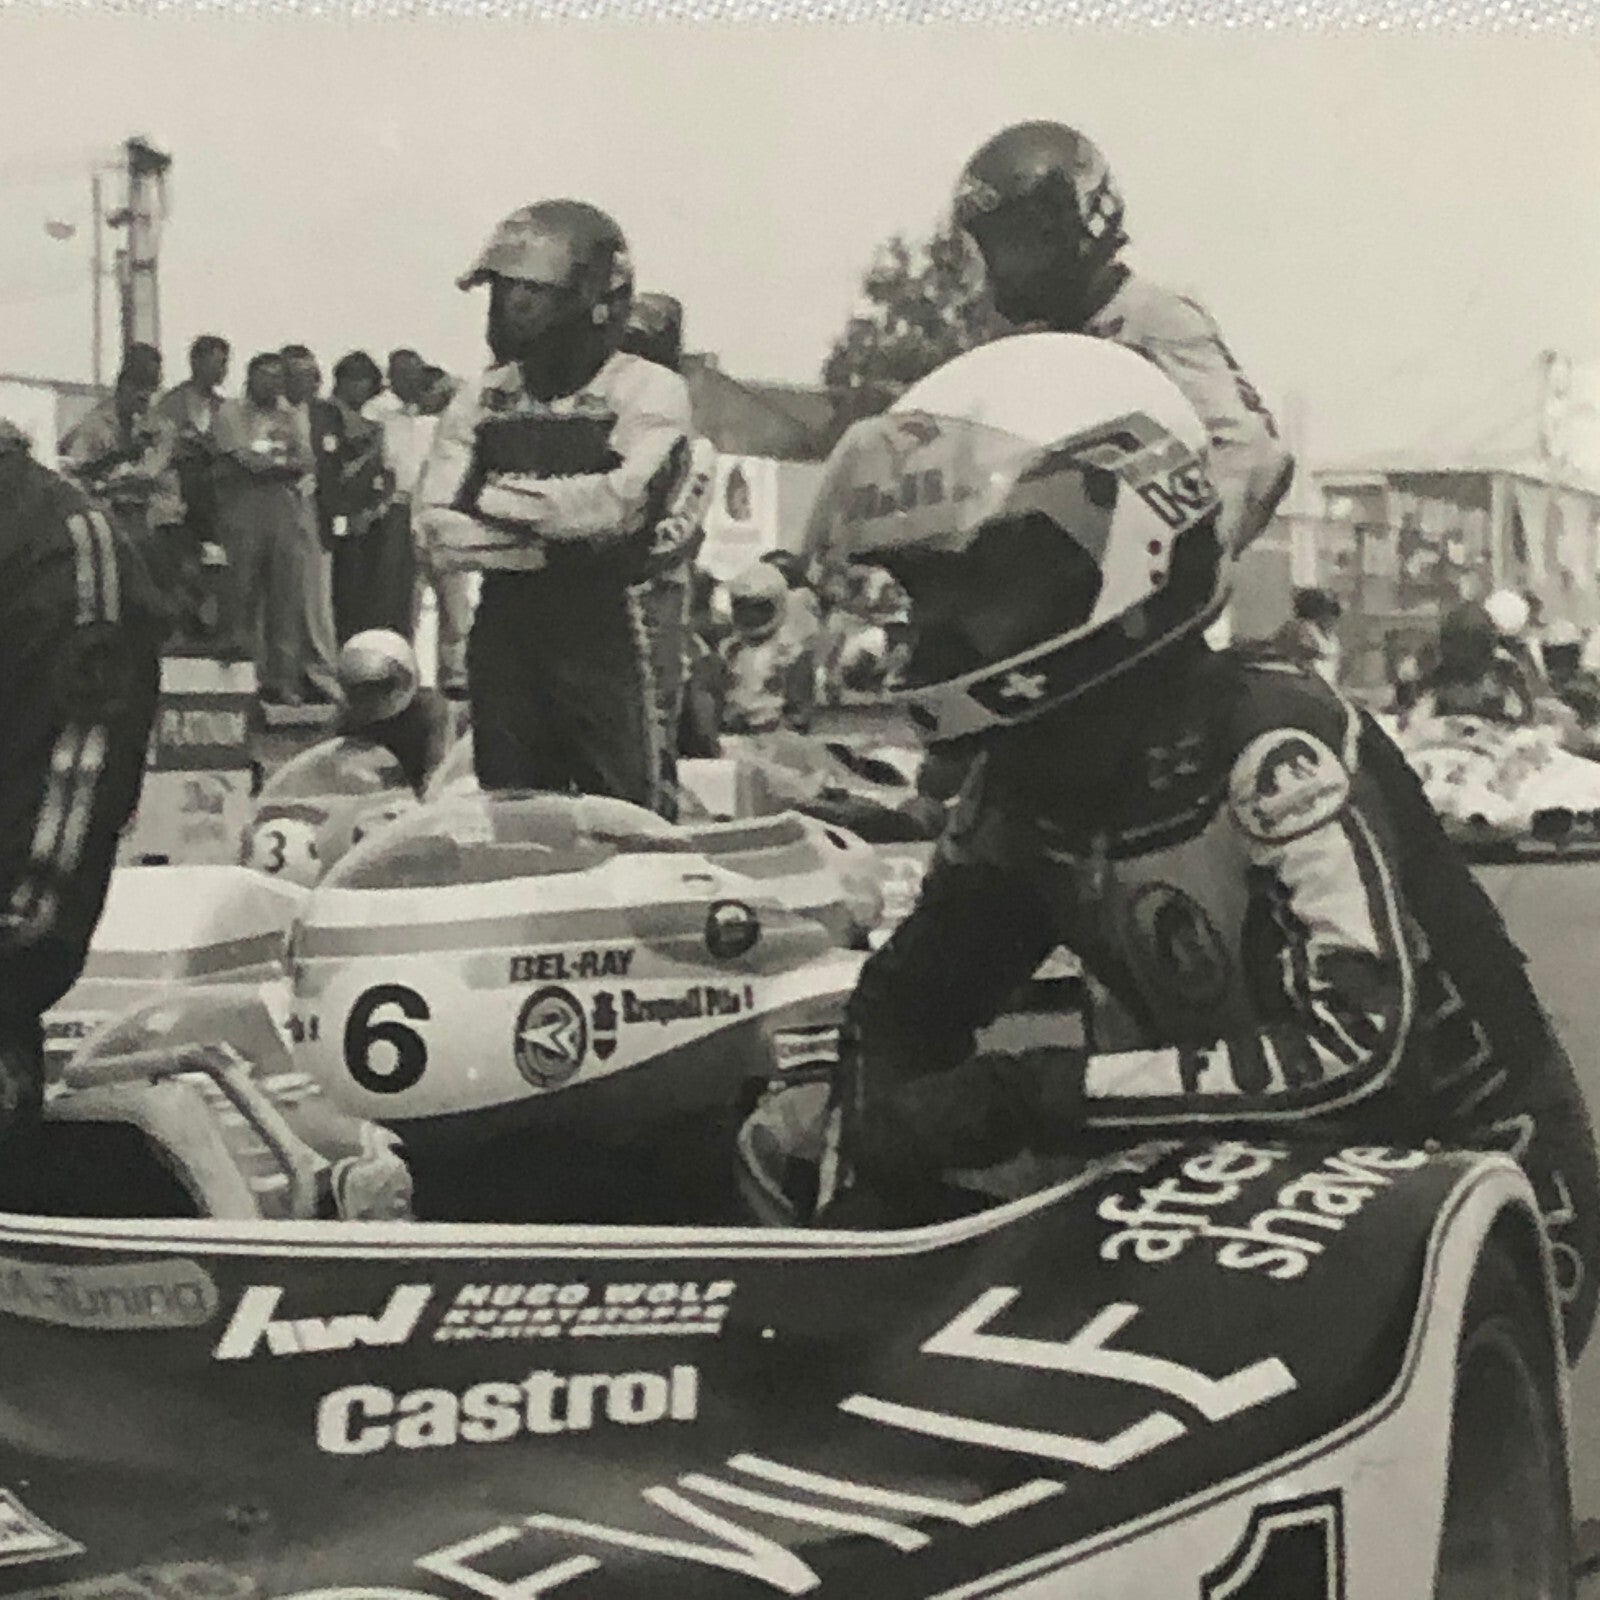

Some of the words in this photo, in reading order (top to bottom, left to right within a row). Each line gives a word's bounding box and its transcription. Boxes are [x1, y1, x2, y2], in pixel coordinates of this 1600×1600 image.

[264, 830, 288, 875] 3
[343, 983, 431, 1094] 6
[1216, 1146, 1431, 1280] shave
[316, 1364, 699, 1455] Castrol
